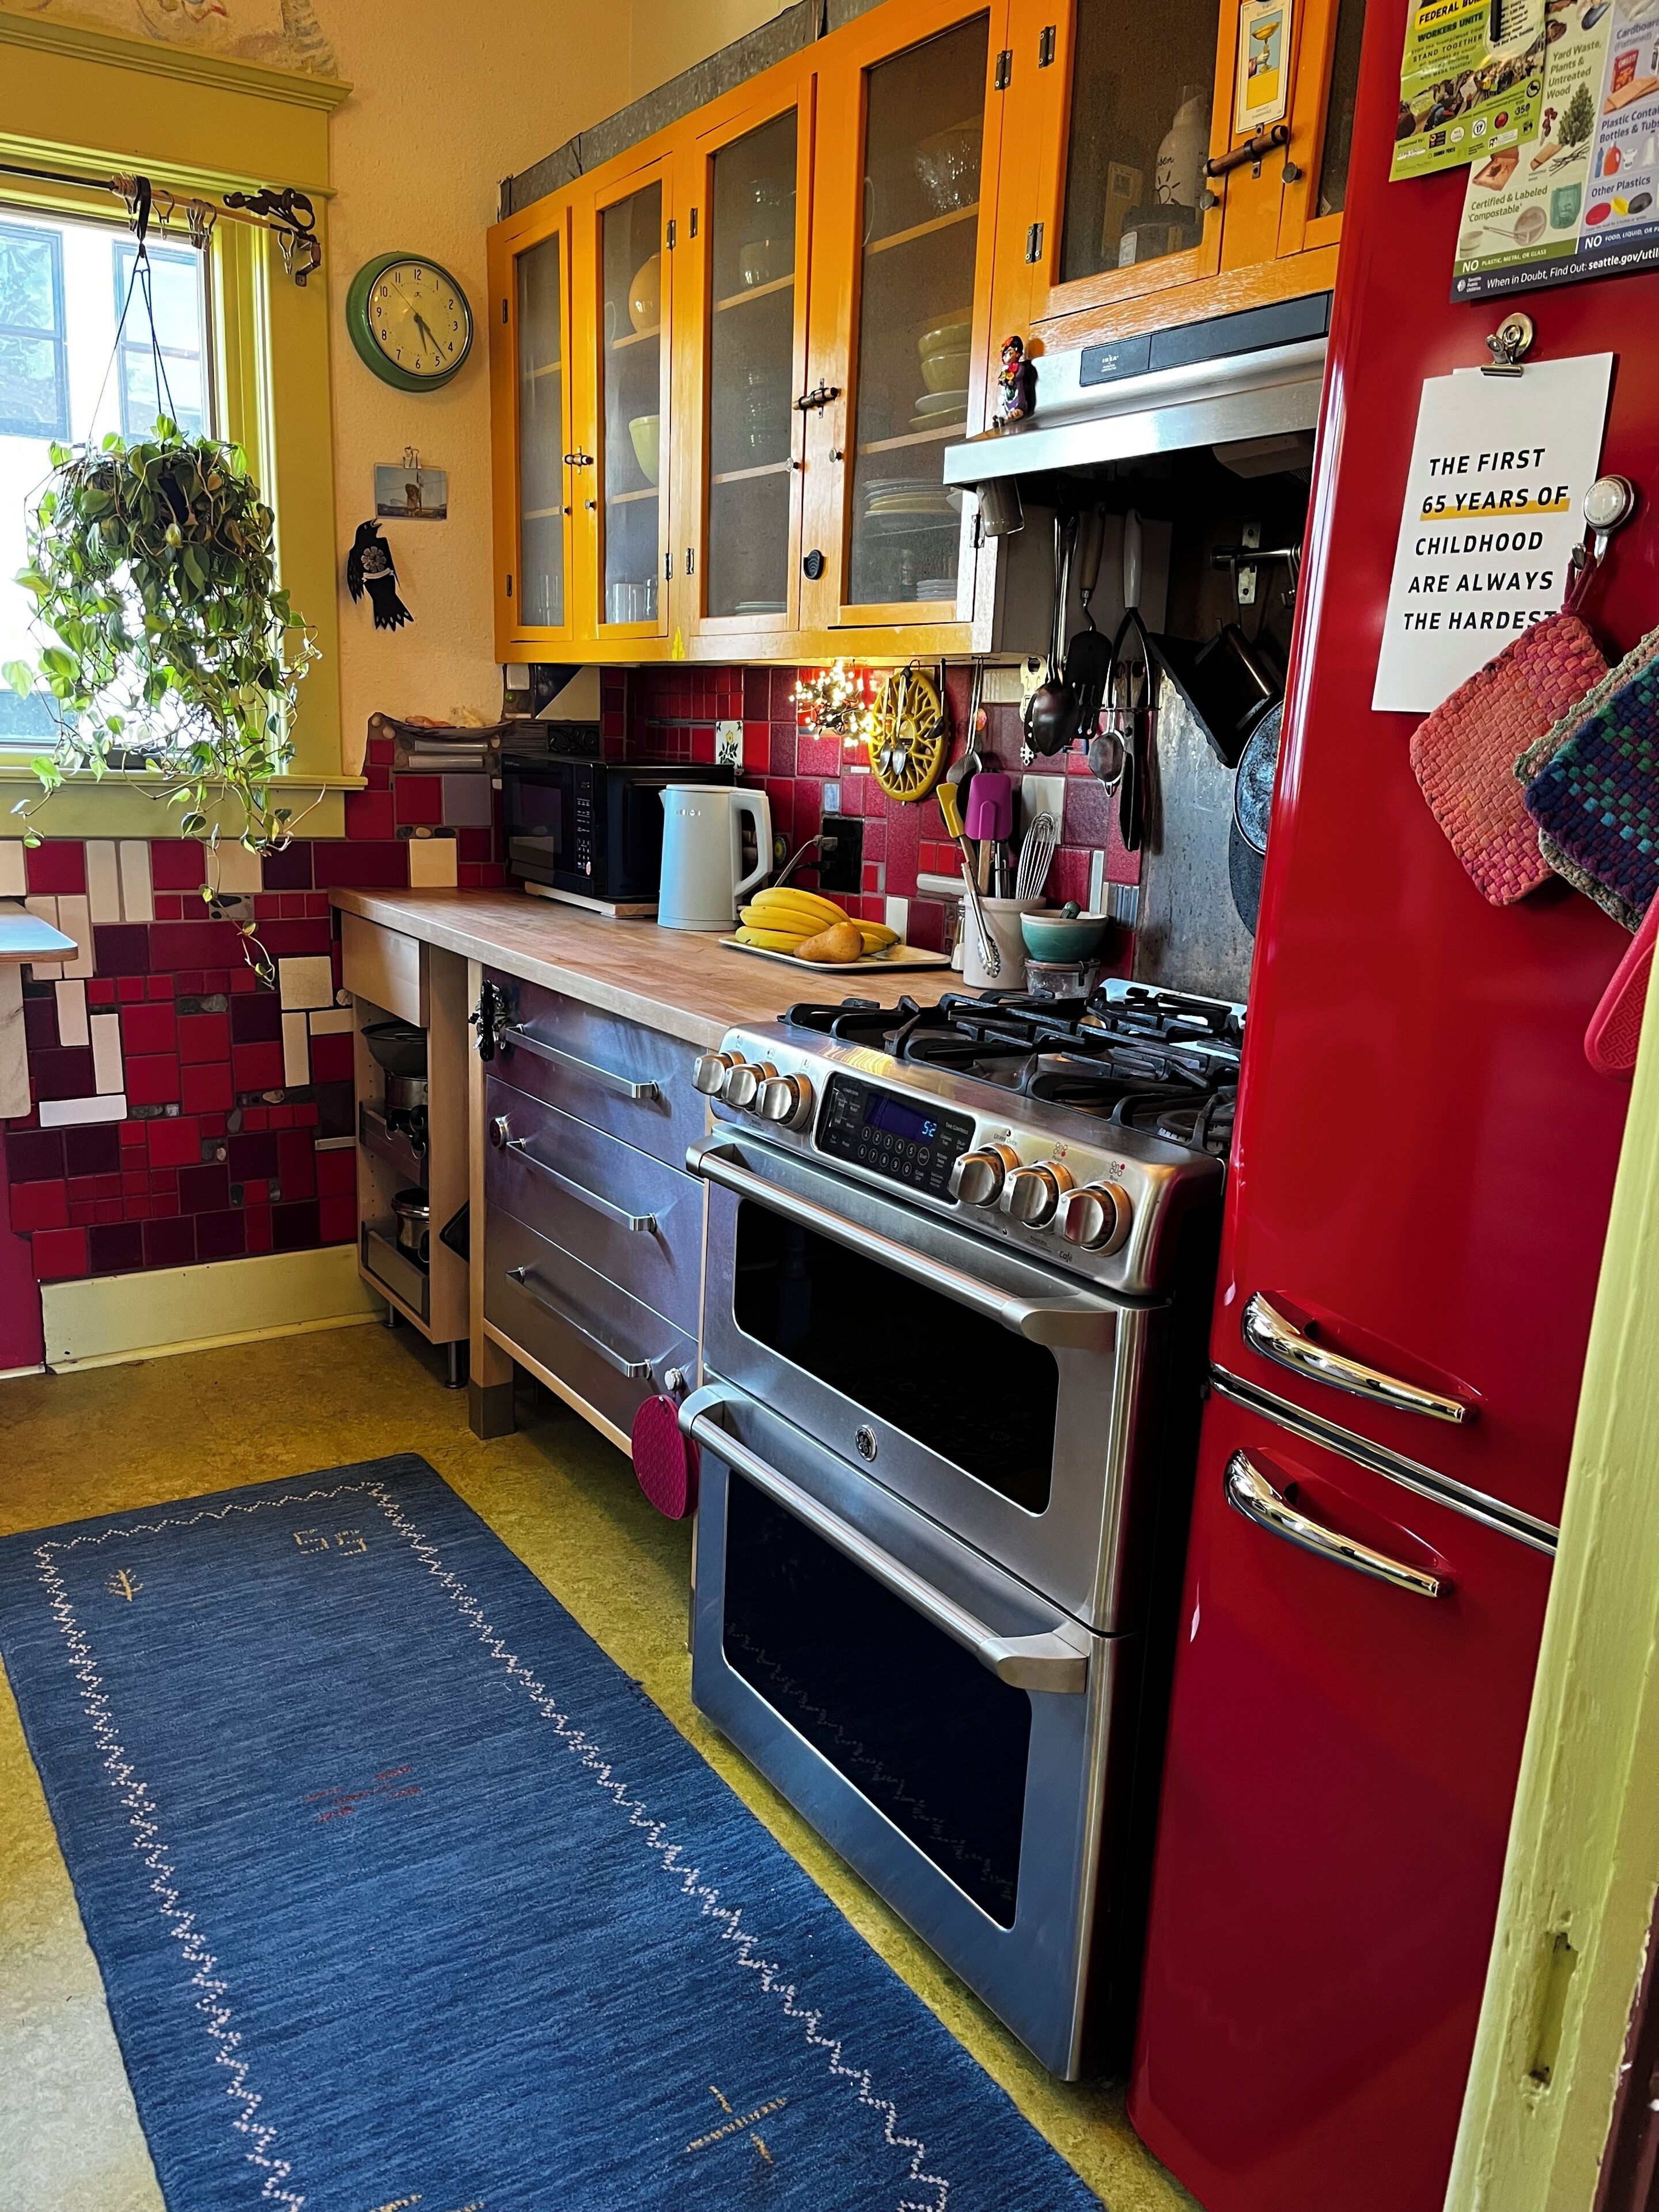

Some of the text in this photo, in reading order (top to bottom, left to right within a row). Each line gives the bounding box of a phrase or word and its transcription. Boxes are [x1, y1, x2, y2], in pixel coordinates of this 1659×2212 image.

[1419, 1, 1459, 25] FEDERAL
[1417, 21, 1457, 43] WORKERS
[1459, 11, 1484, 27] UNITE
[1412, 49, 1439, 63] STAND
[1442, 33, 1483, 53] TOGETHER
[1553, 40, 1601, 62] Yard Waste,
[1550, 56, 1585, 75] Plants &
[1548, 66, 1592, 87] Untreated
[1547, 85, 1571, 100] Wood
[1476, 124, 1482, 132] 17
[1601, 115, 1629, 131] Plastic
[1599, 128, 1630, 143] Bottles
[1631, 124, 1638, 134] &
[1592, 176, 1651, 198] Other Plastics
[1471, 185, 1548, 211] Certified & Labeled
[1585, 235, 1603, 249] NO
[1622, 229, 1643, 238] LIQUID,
[1462, 260, 1479, 273] NO
[1503, 254, 1521, 262] METAL,
[1531, 249, 1547, 257] GLASS
[1487, 248, 1659, 289] When in Doubt, Find Out: seattle.gov/util
[395, 272, 401, 283] 11
[414, 269, 422, 281] 12
[380, 286, 388, 297] 10
[377, 307, 382, 317] 9
[449, 299, 454, 309] 2
[381, 329, 387, 340] 8
[453, 321, 458, 331] 3
[396, 349, 402, 361] 7
[448, 342, 453, 352] 4
[415, 359, 421, 369] 6
[435, 356, 440, 366] 5
[1430, 448, 1546, 477] THE FIRST
[1422, 494, 1446, 514] 65
[1455, 487, 1529, 511] YEARS
[1537, 485, 1569, 506] OF
[1415, 531, 1544, 556] CHILDHOOD
[1408, 570, 1554, 593] ARE ALWAYS
[1403, 612, 1441, 631] THE
